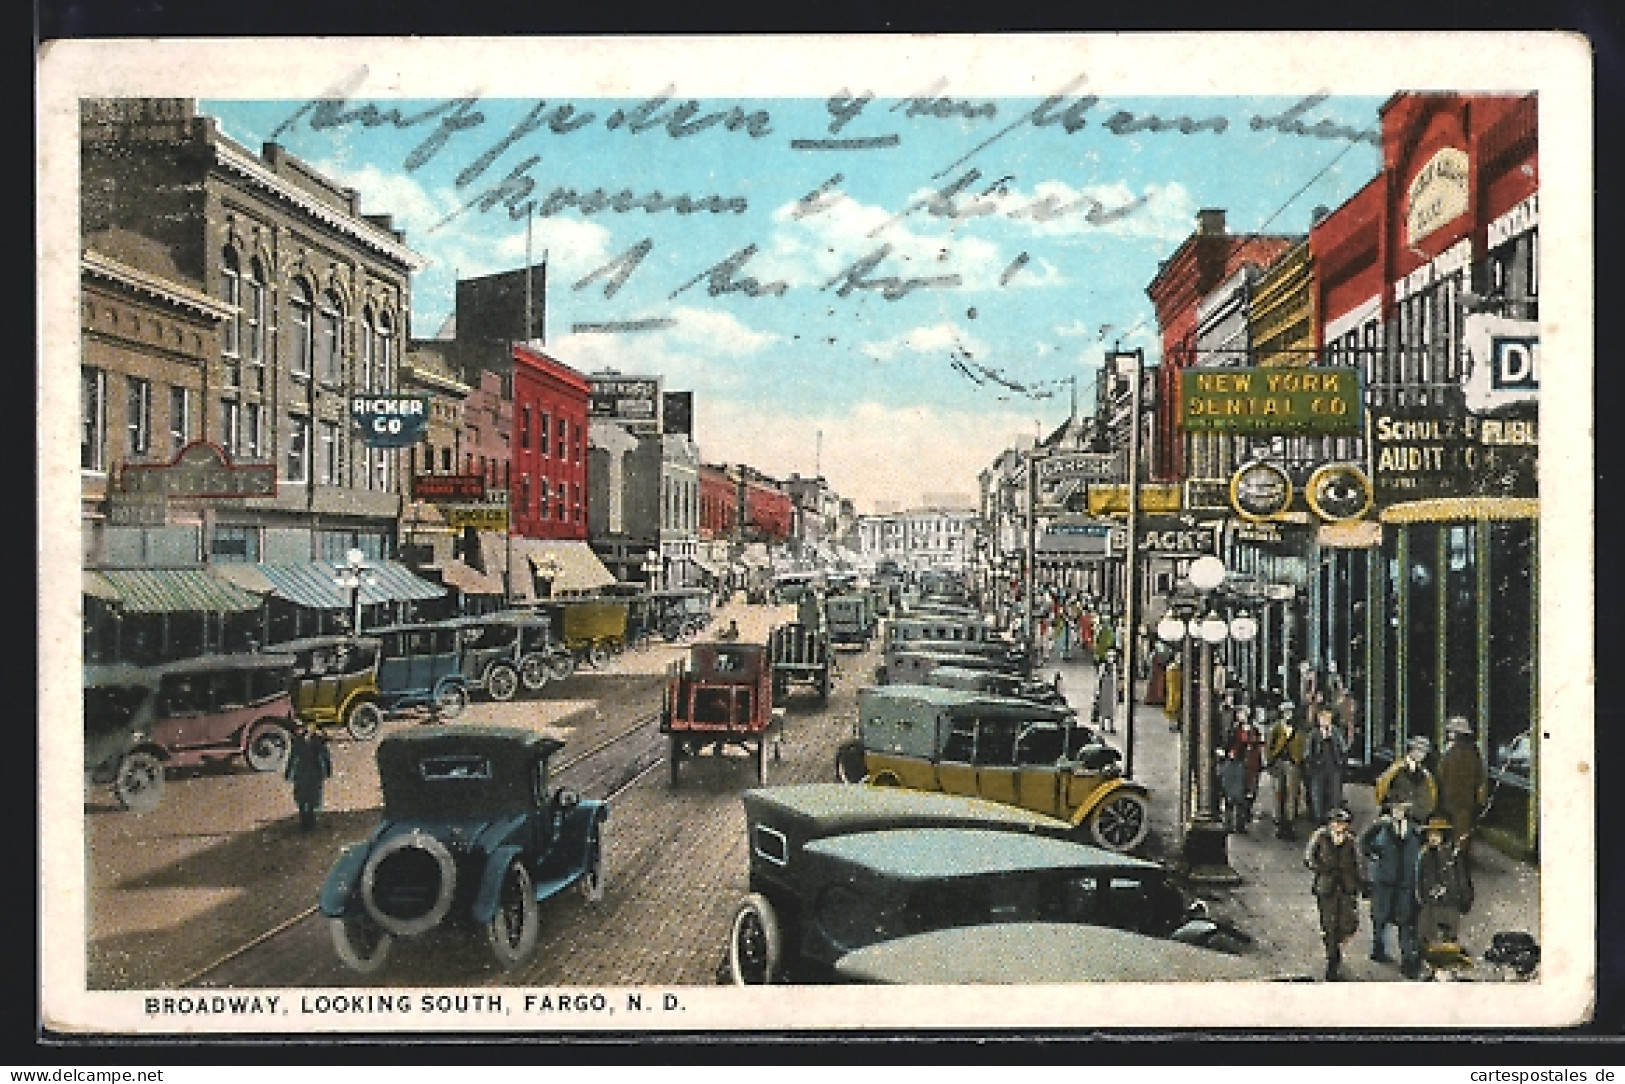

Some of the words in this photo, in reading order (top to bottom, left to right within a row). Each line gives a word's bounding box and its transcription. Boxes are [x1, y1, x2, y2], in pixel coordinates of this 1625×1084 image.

[1197, 374, 1251, 392] NEW
[1267, 373, 1339, 392] YORK
[1189, 397, 1295, 415] DENTAL
[1311, 397, 1347, 415] CO
[372, 416, 404, 434] CO
[1379, 447, 1444, 471] AUDIT
[301, 995, 412, 1014] LOOKING
[421, 995, 510, 1016] SOUTH,
[525, 993, 614, 1016] FARGO,
[627, 994, 652, 1011] N.
[663, 993, 686, 1011] D.
